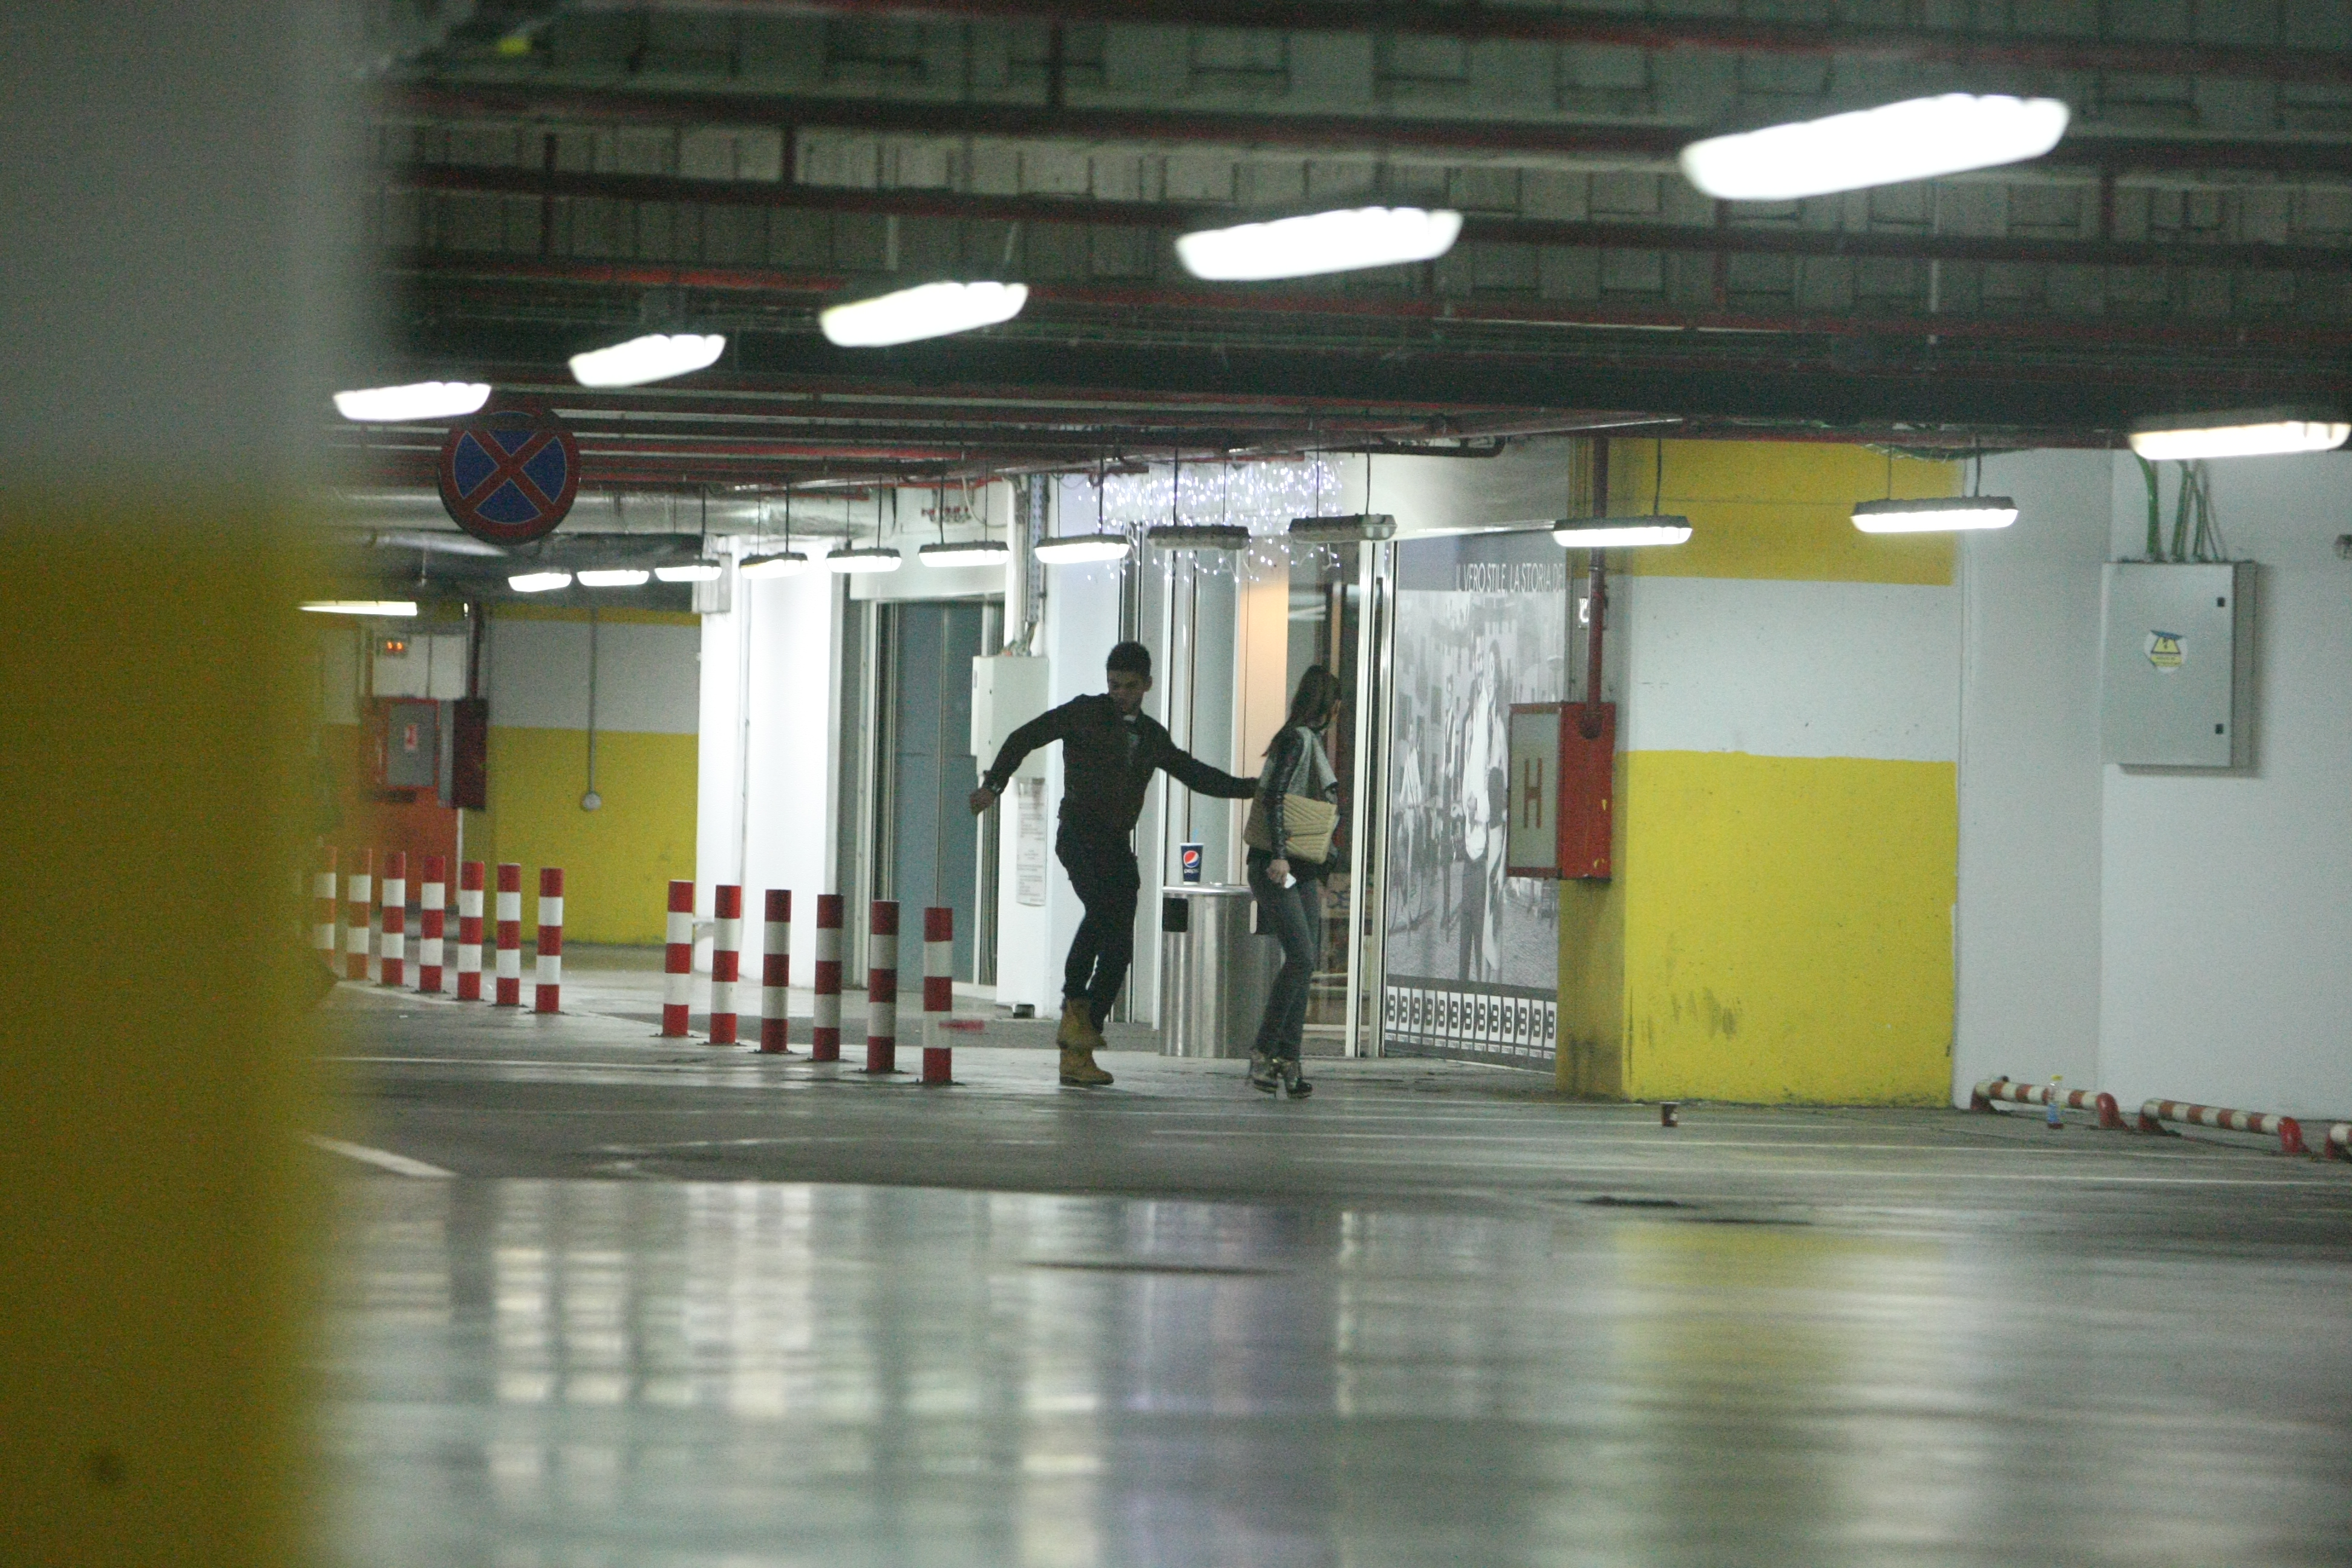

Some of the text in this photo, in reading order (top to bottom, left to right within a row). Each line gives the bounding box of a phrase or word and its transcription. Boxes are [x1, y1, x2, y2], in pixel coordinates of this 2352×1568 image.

[1456, 564, 1462, 592] IL
[1464, 563, 1486, 593] VERO
[1510, 563, 1520, 592] LA
[1521, 563, 1551, 593] STORIA
[1524, 757, 1543, 829] H
